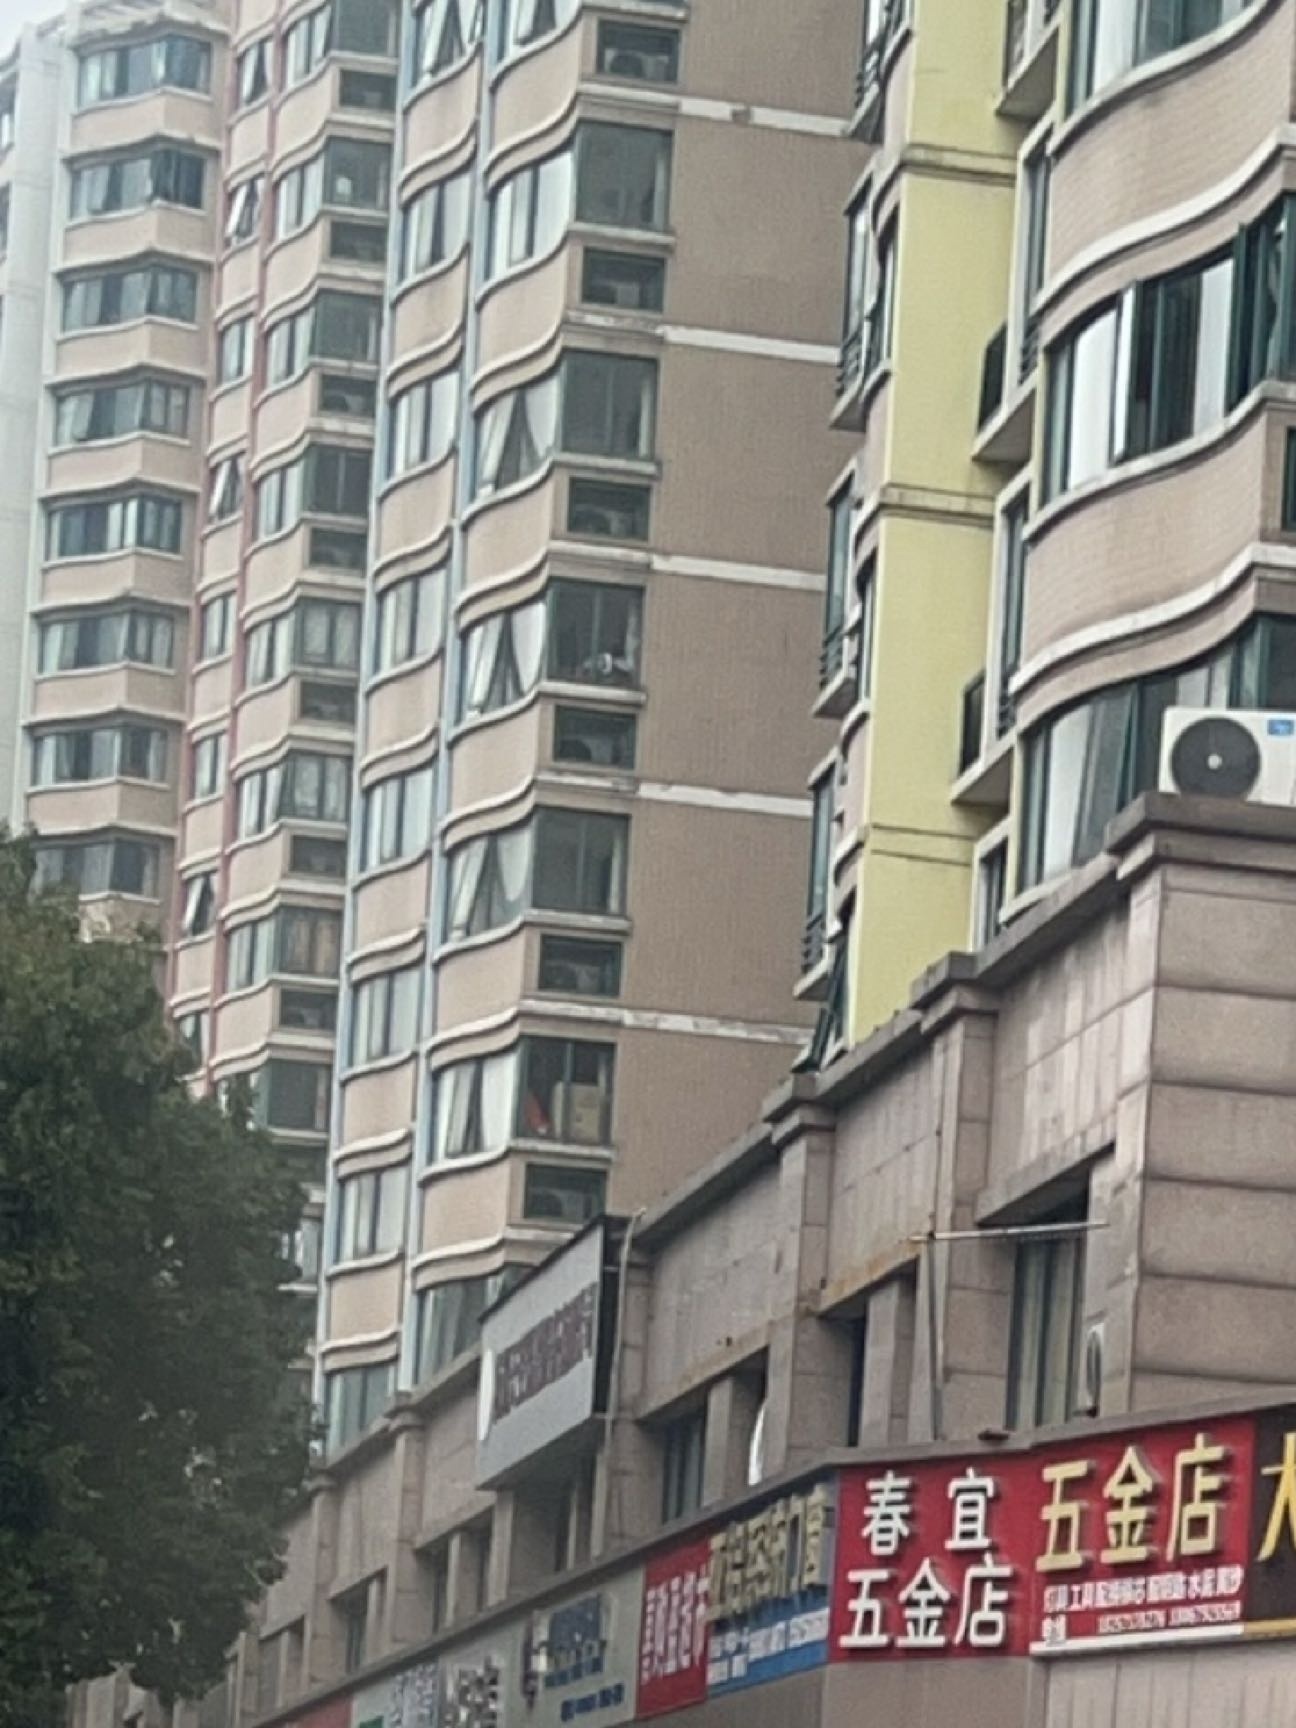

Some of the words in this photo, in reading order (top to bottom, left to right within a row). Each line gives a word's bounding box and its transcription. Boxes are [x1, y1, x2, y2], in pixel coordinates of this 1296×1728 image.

[862, 1468, 995, 1556] 春宜
[1036, 1432, 1229, 1573] 五金店
[838, 1553, 1014, 1649] 五金店
